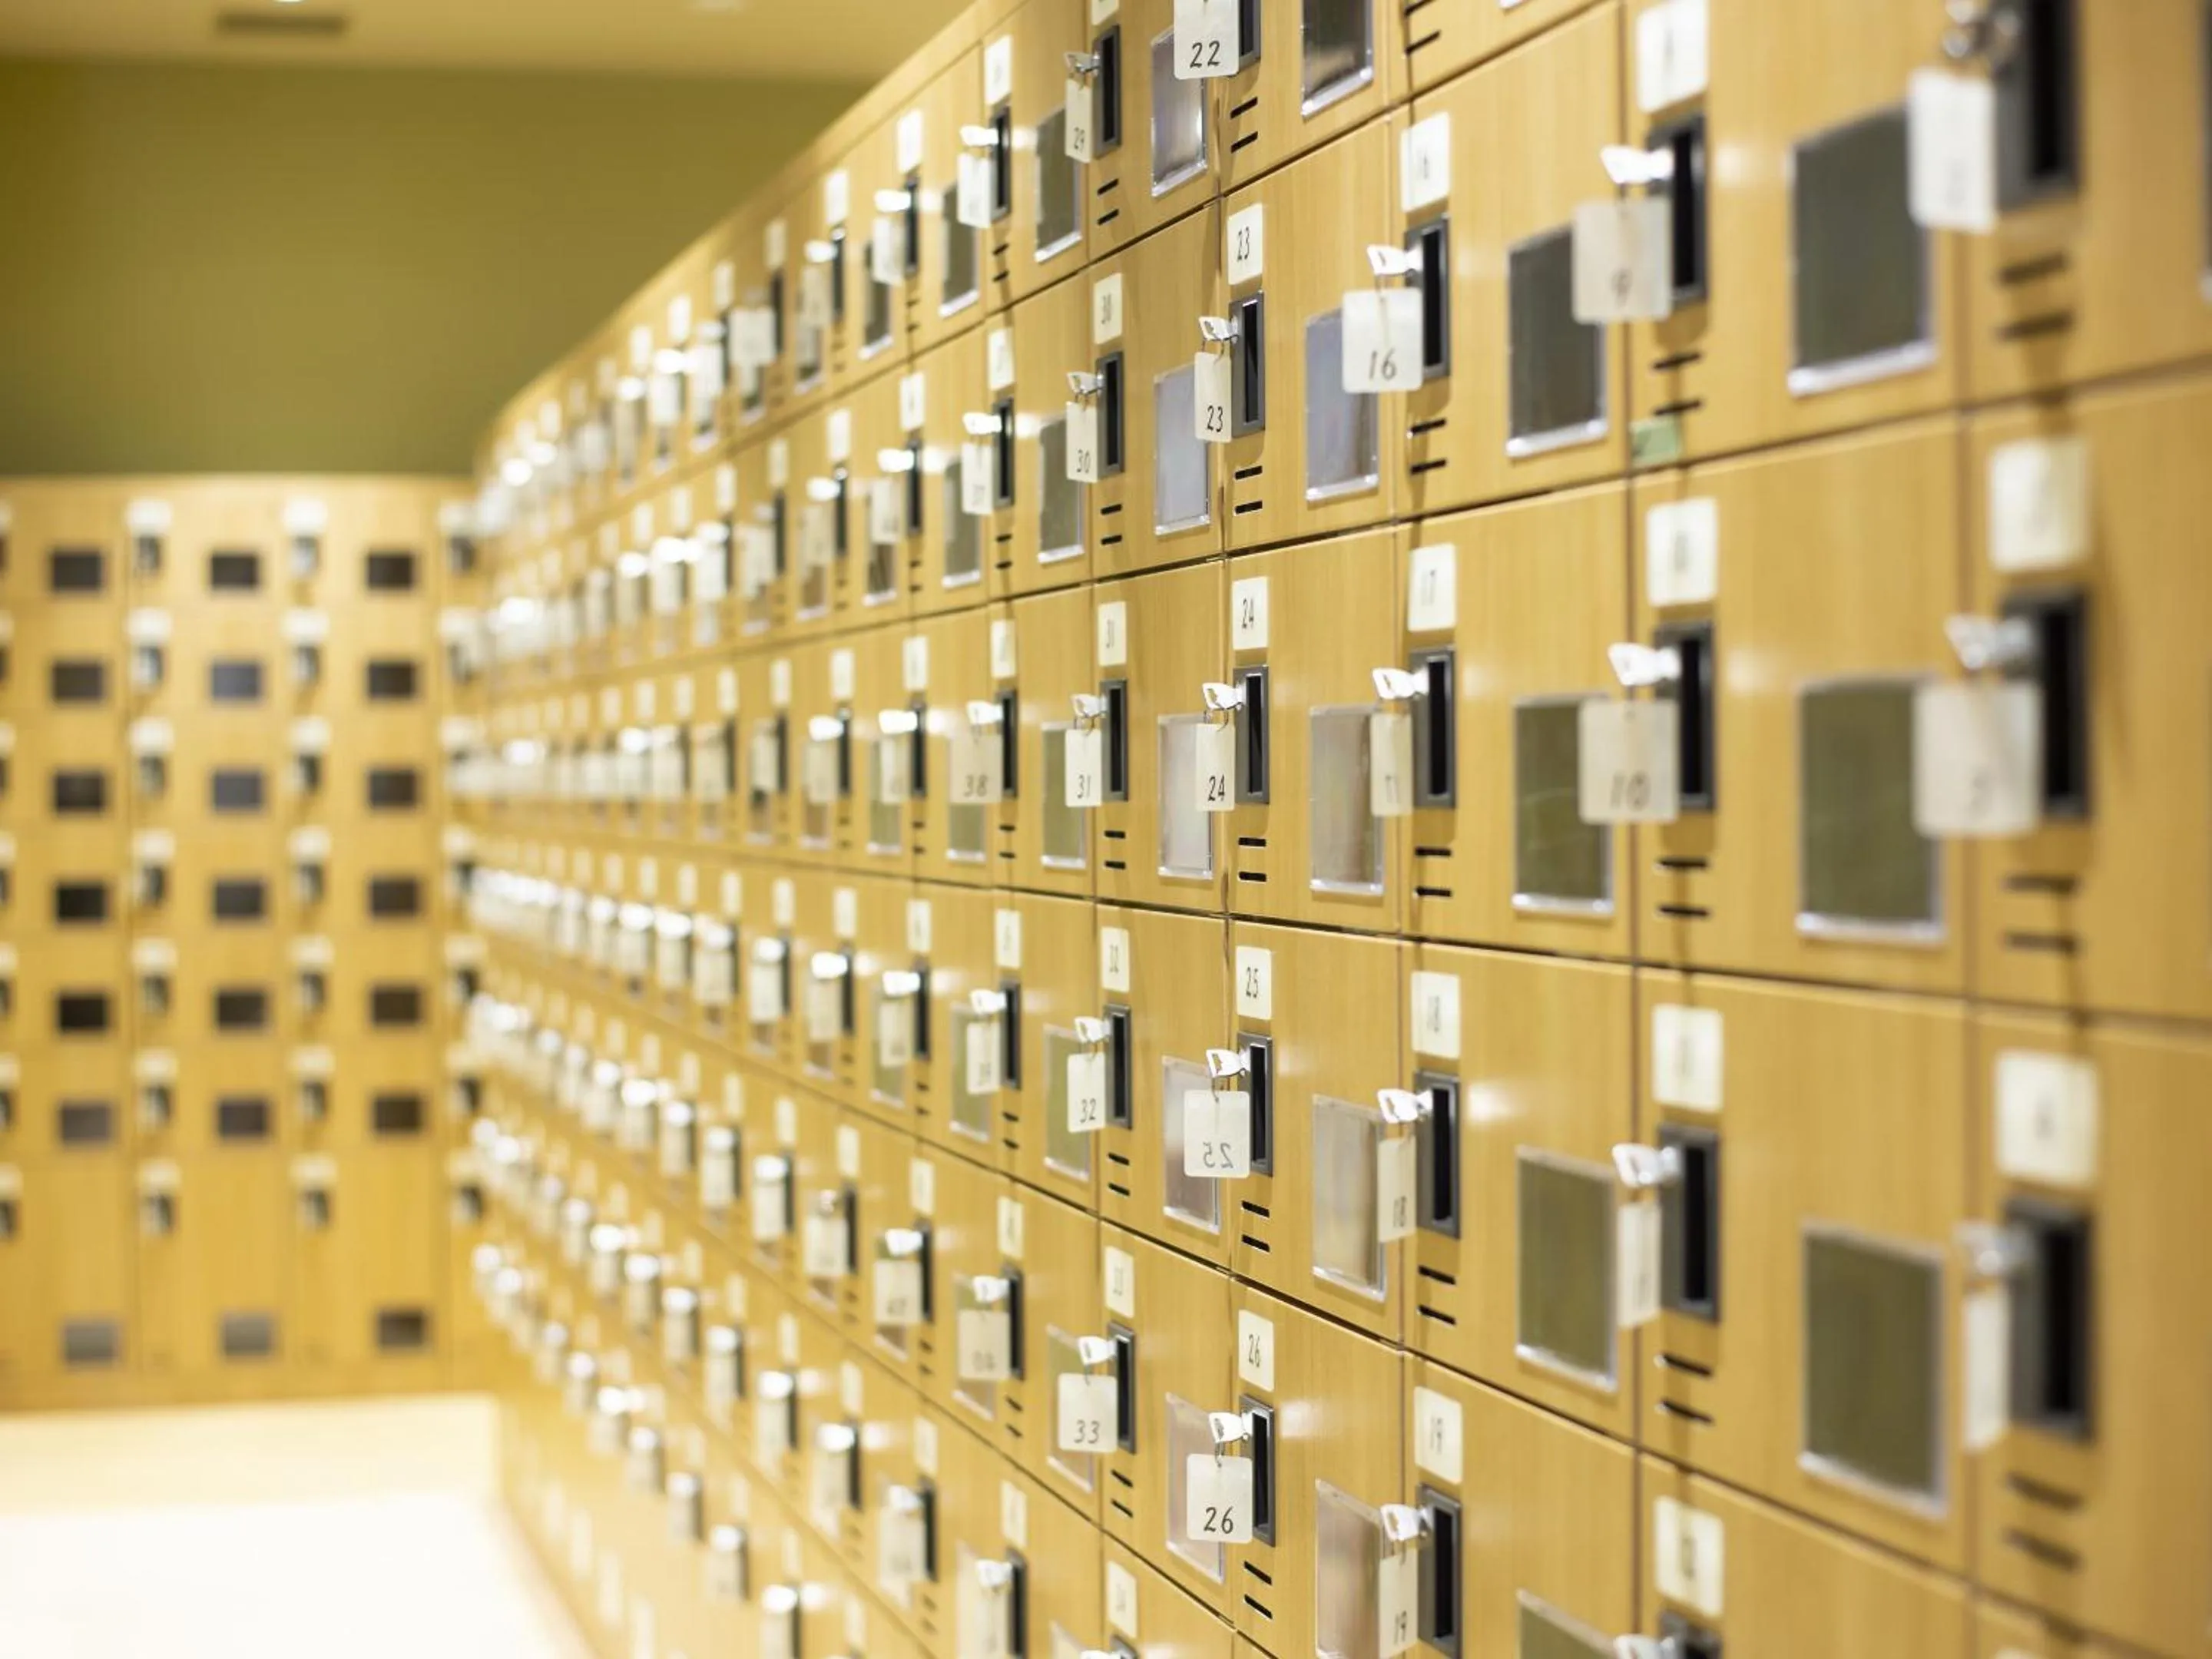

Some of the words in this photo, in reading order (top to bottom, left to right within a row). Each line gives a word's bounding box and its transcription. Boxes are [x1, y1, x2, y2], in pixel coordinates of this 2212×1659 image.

[1190, 40, 1222, 69] 22
[1237, 225, 1250, 263] 23
[1369, 347, 1398, 382] 16
[1206, 404, 1224, 432] 23
[1076, 449, 1091, 474] 30
[1241, 598, 1254, 630] 24
[963, 773, 989, 798] 38
[1076, 773, 1091, 800] 31
[1207, 773, 1225, 802] 24
[1610, 770, 1651, 812] 10
[1246, 965, 1261, 1000] 25
[1079, 1097, 1097, 1124] 32
[1248, 1333, 1262, 1369] 26
[1073, 1419, 1100, 1445] 33
[1204, 1505, 1234, 1535] 26
